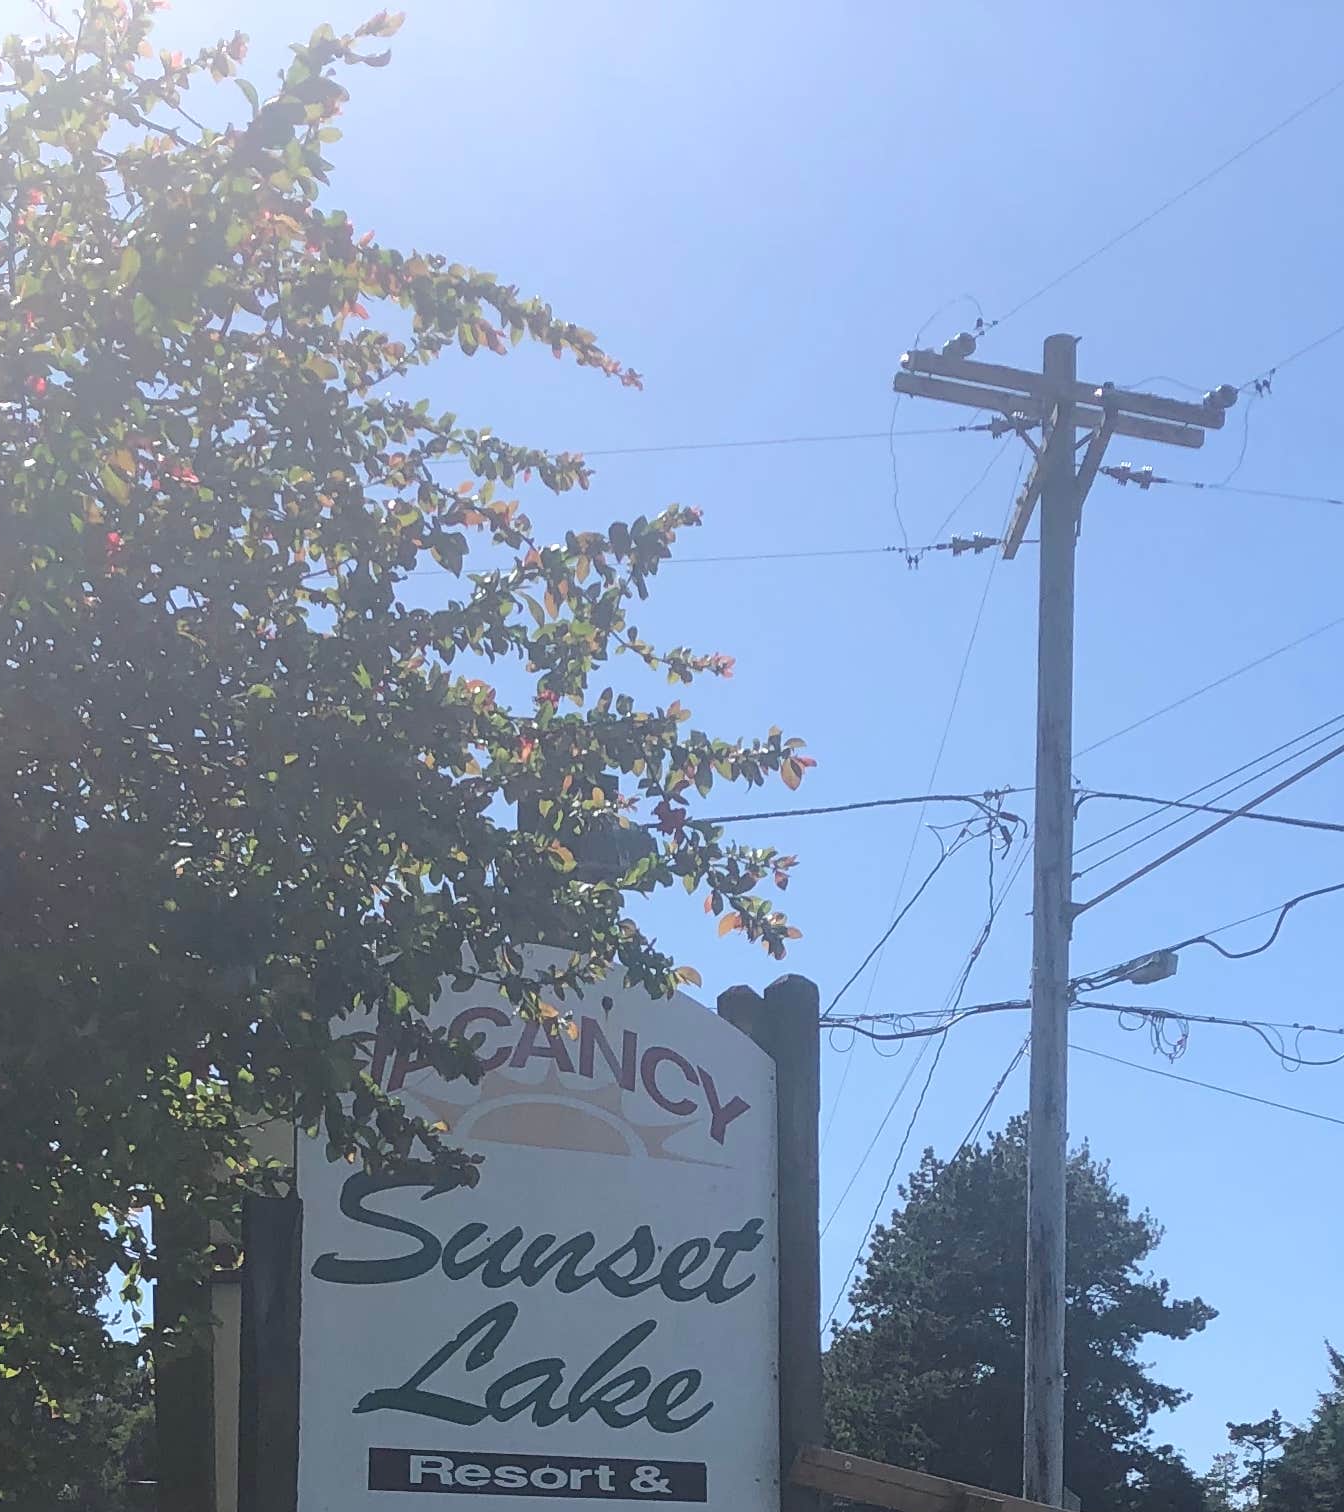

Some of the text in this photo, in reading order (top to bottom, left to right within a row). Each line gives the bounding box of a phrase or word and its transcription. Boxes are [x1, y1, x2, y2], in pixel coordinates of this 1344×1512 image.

[311, 1168, 764, 1303] Sunset
[352, 1301, 714, 1433] Lake
[409, 1454, 672, 1494] Resort &
